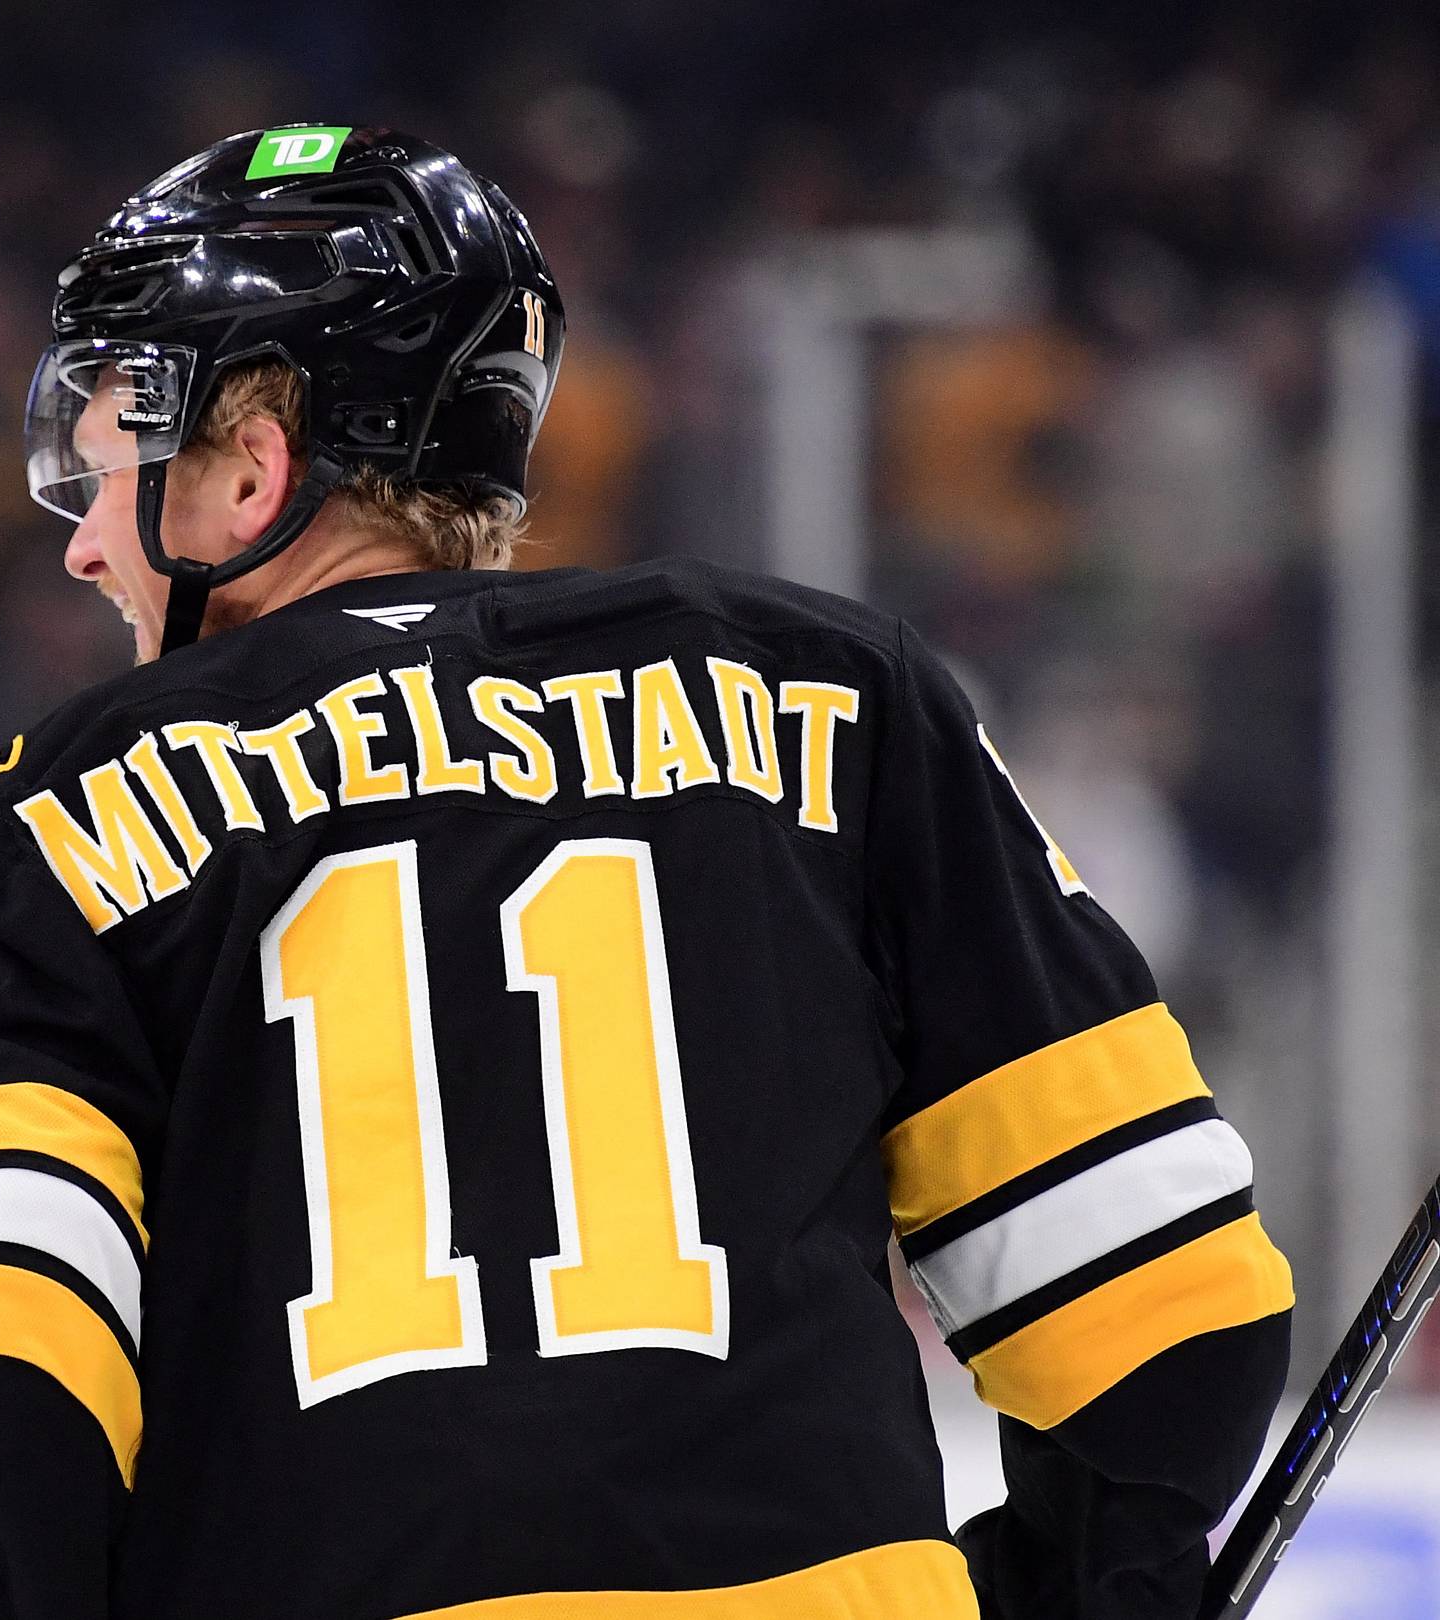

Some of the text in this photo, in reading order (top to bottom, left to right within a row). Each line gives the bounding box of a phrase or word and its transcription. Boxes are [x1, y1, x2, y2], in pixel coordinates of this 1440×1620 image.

[268, 132, 335, 168] TD
[522, 290, 546, 361] 11
[120, 411, 172, 425] BAUER
[13, 655, 860, 936] MITTELSTADT
[259, 837, 729, 1410] 11
